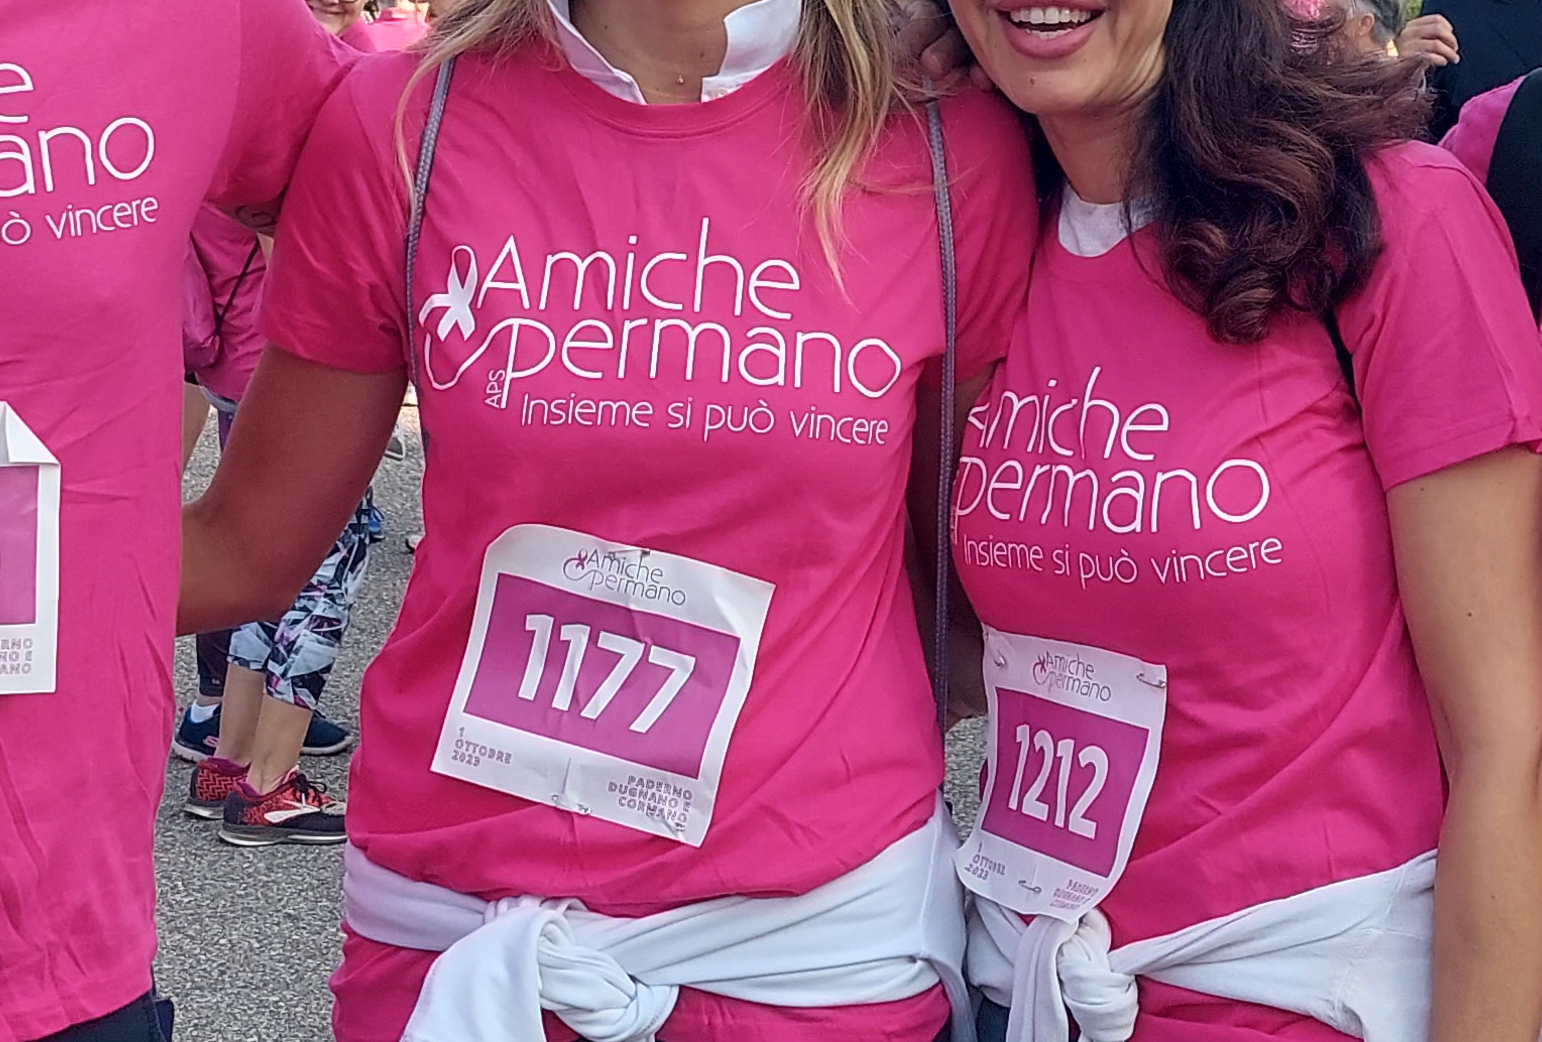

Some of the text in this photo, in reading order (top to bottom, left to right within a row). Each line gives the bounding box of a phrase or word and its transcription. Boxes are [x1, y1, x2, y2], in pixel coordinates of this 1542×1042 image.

[47, 194, 159, 240] vincere
[476, 217, 801, 320] Amiche
[484, 368, 506, 409] APS
[500, 317, 902, 409] permano
[520, 391, 890, 446] Insieme si può vincere
[952, 456, 1270, 545] permano
[585, 548, 664, 585] Amiche
[963, 534, 1283, 590] Insieme si può vincere
[517, 613, 696, 734] 1177
[1045, 650, 1095, 681] Amiche
[454, 739, 512, 765] OTTOBRE
[627, 774, 693, 801] PADERNO
[1008, 723, 1109, 840] 1212
